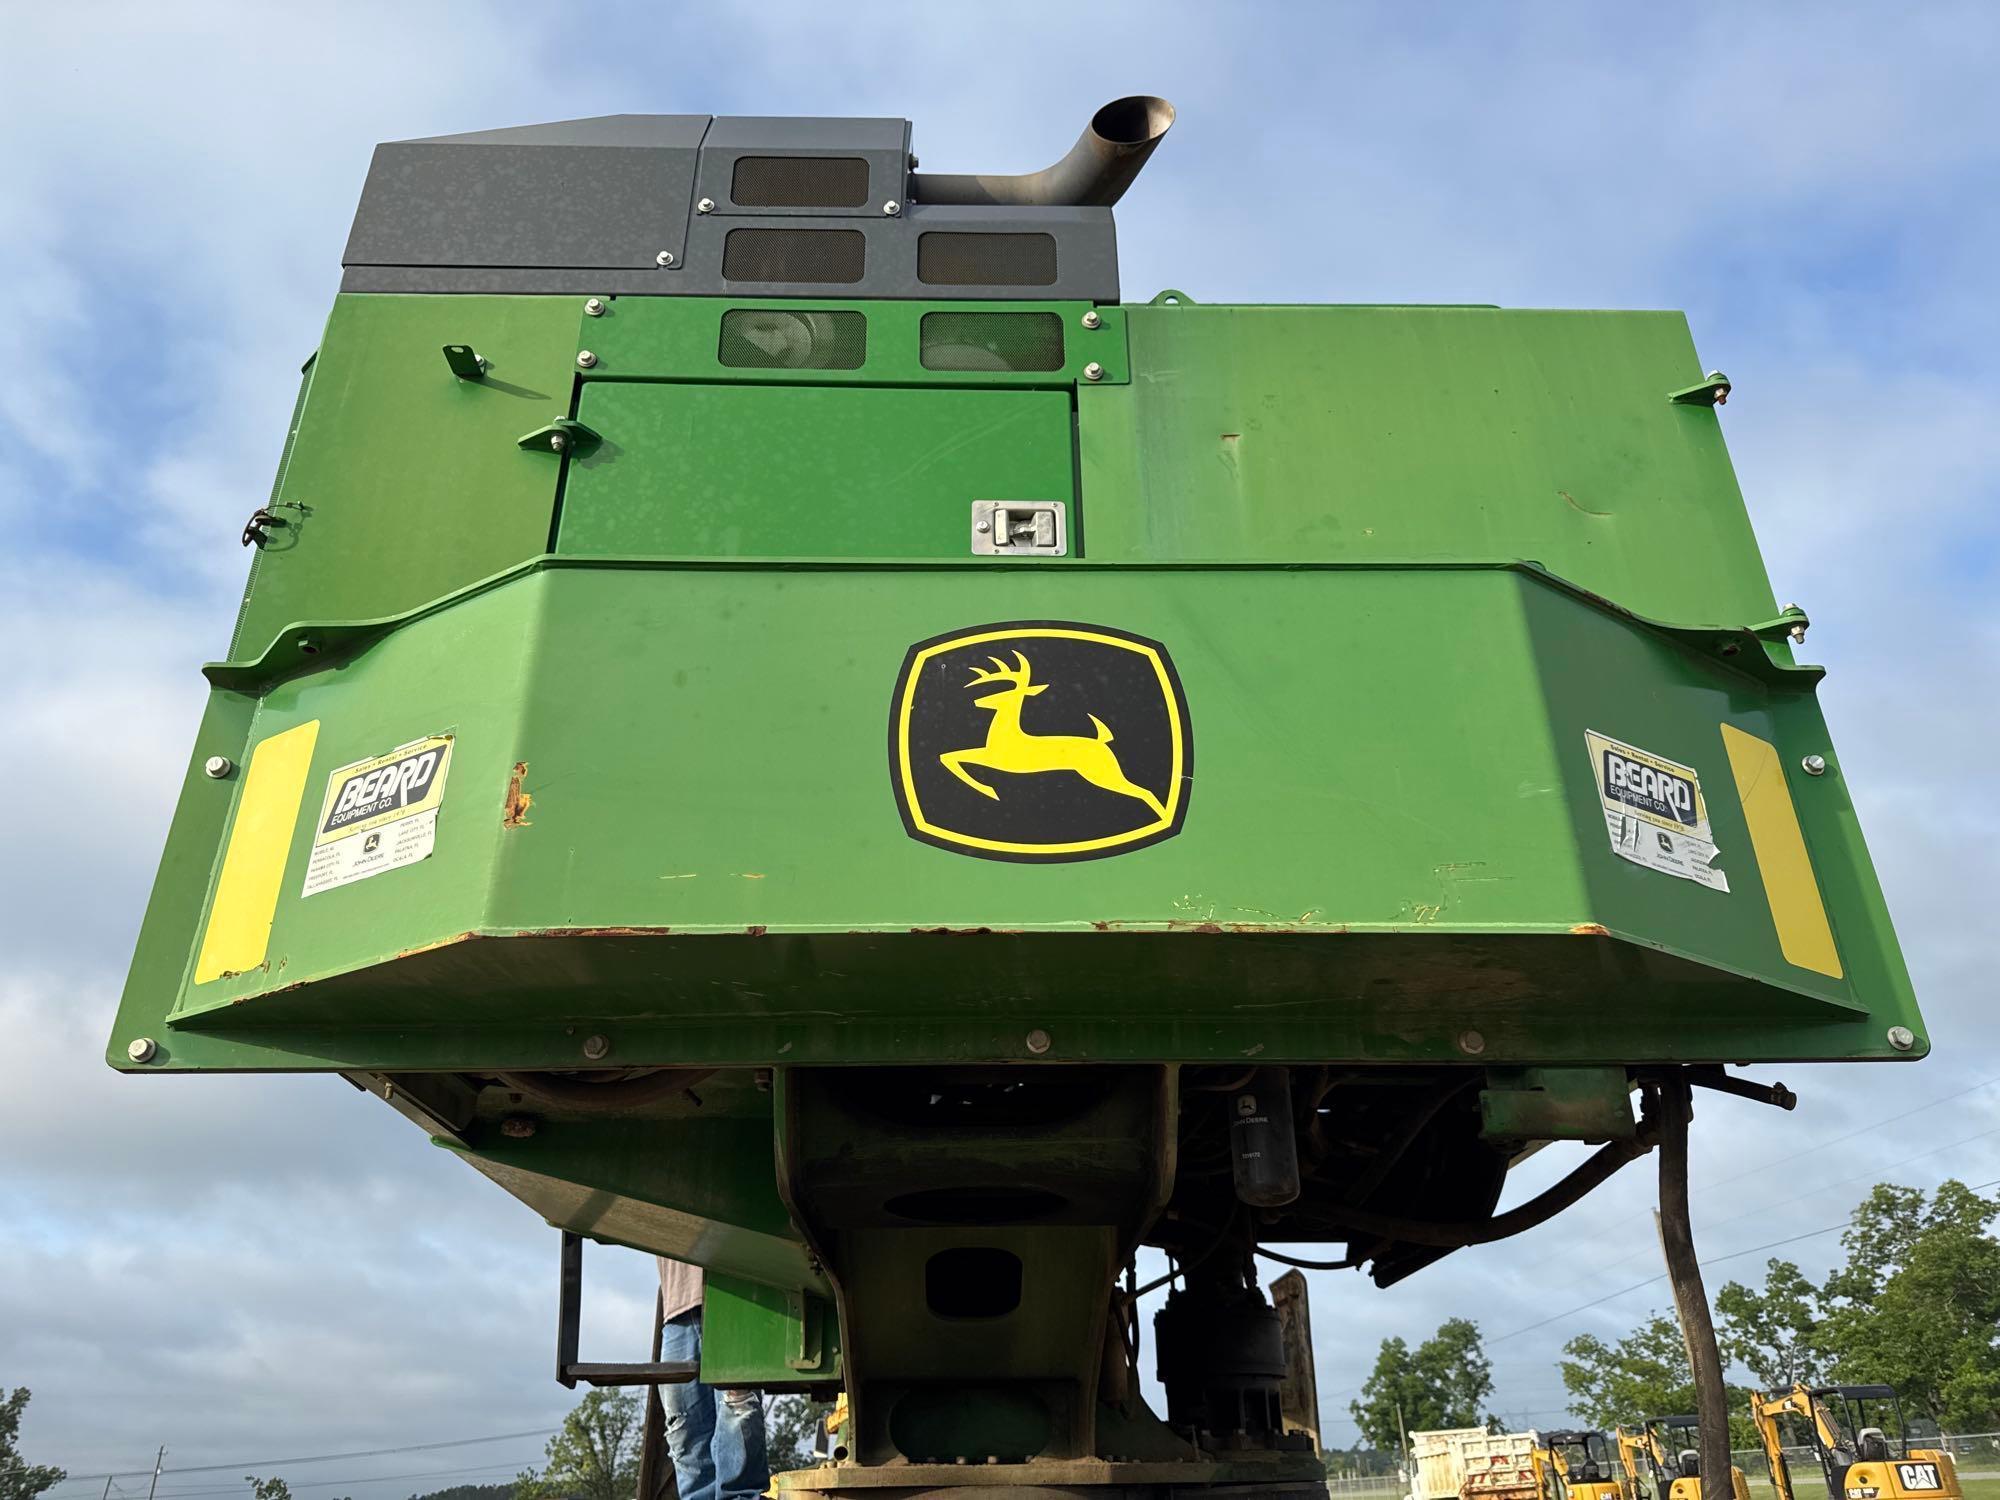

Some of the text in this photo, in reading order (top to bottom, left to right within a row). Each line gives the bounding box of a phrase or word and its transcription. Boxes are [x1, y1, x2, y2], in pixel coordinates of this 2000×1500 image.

[1609, 744, 1675, 772] Sales Rental Service
[334, 751, 437, 813] BEARD
[1608, 754, 1691, 822] BEARD
[1610, 786, 1653, 808] EQUIPMENT
[330, 797, 392, 826] EQUIPMENT CO.
[1245, 1116, 1269, 1124] DEERE
[1900, 1465, 1938, 1490] CAT
